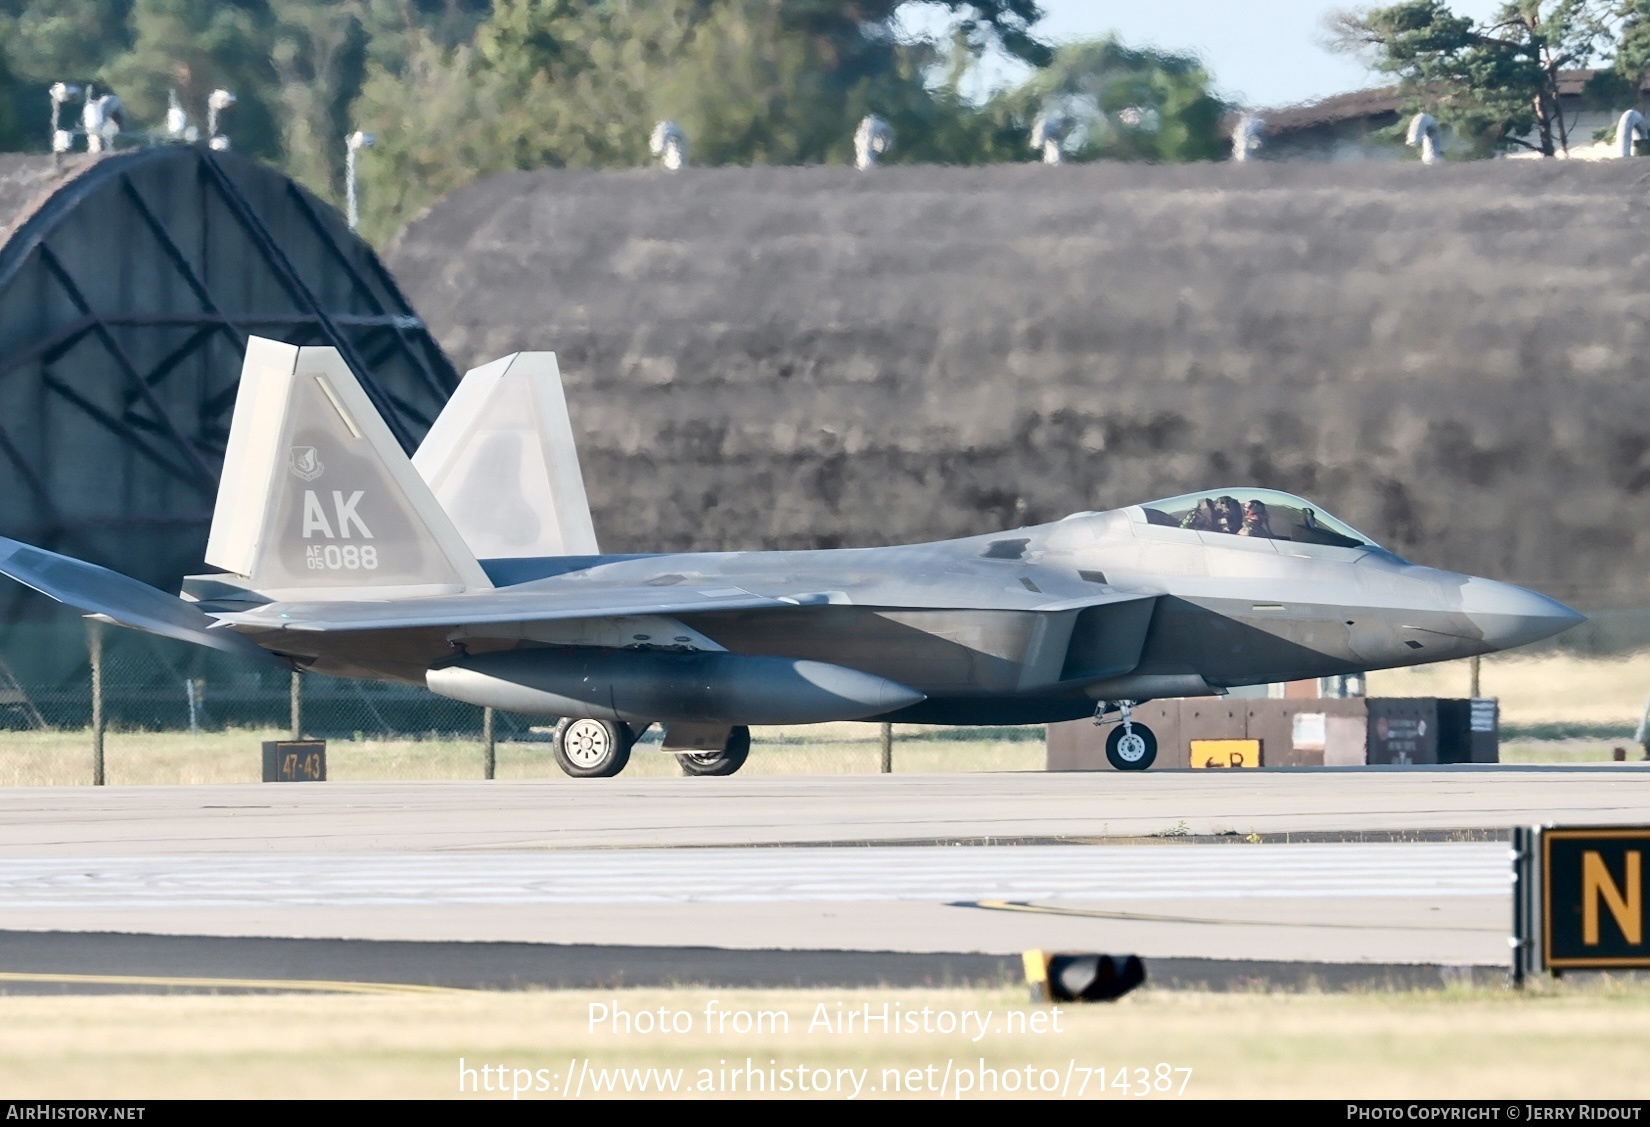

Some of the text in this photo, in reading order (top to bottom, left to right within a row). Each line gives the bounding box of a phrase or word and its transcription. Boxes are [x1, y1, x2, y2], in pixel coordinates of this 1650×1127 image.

[302, 489, 374, 539] AK
[306, 545, 322, 557] AF
[307, 557, 325, 570] 05
[324, 545, 379, 570] 088
[283, 753, 320, 779] 47-43
[1583, 850, 1642, 946] N
